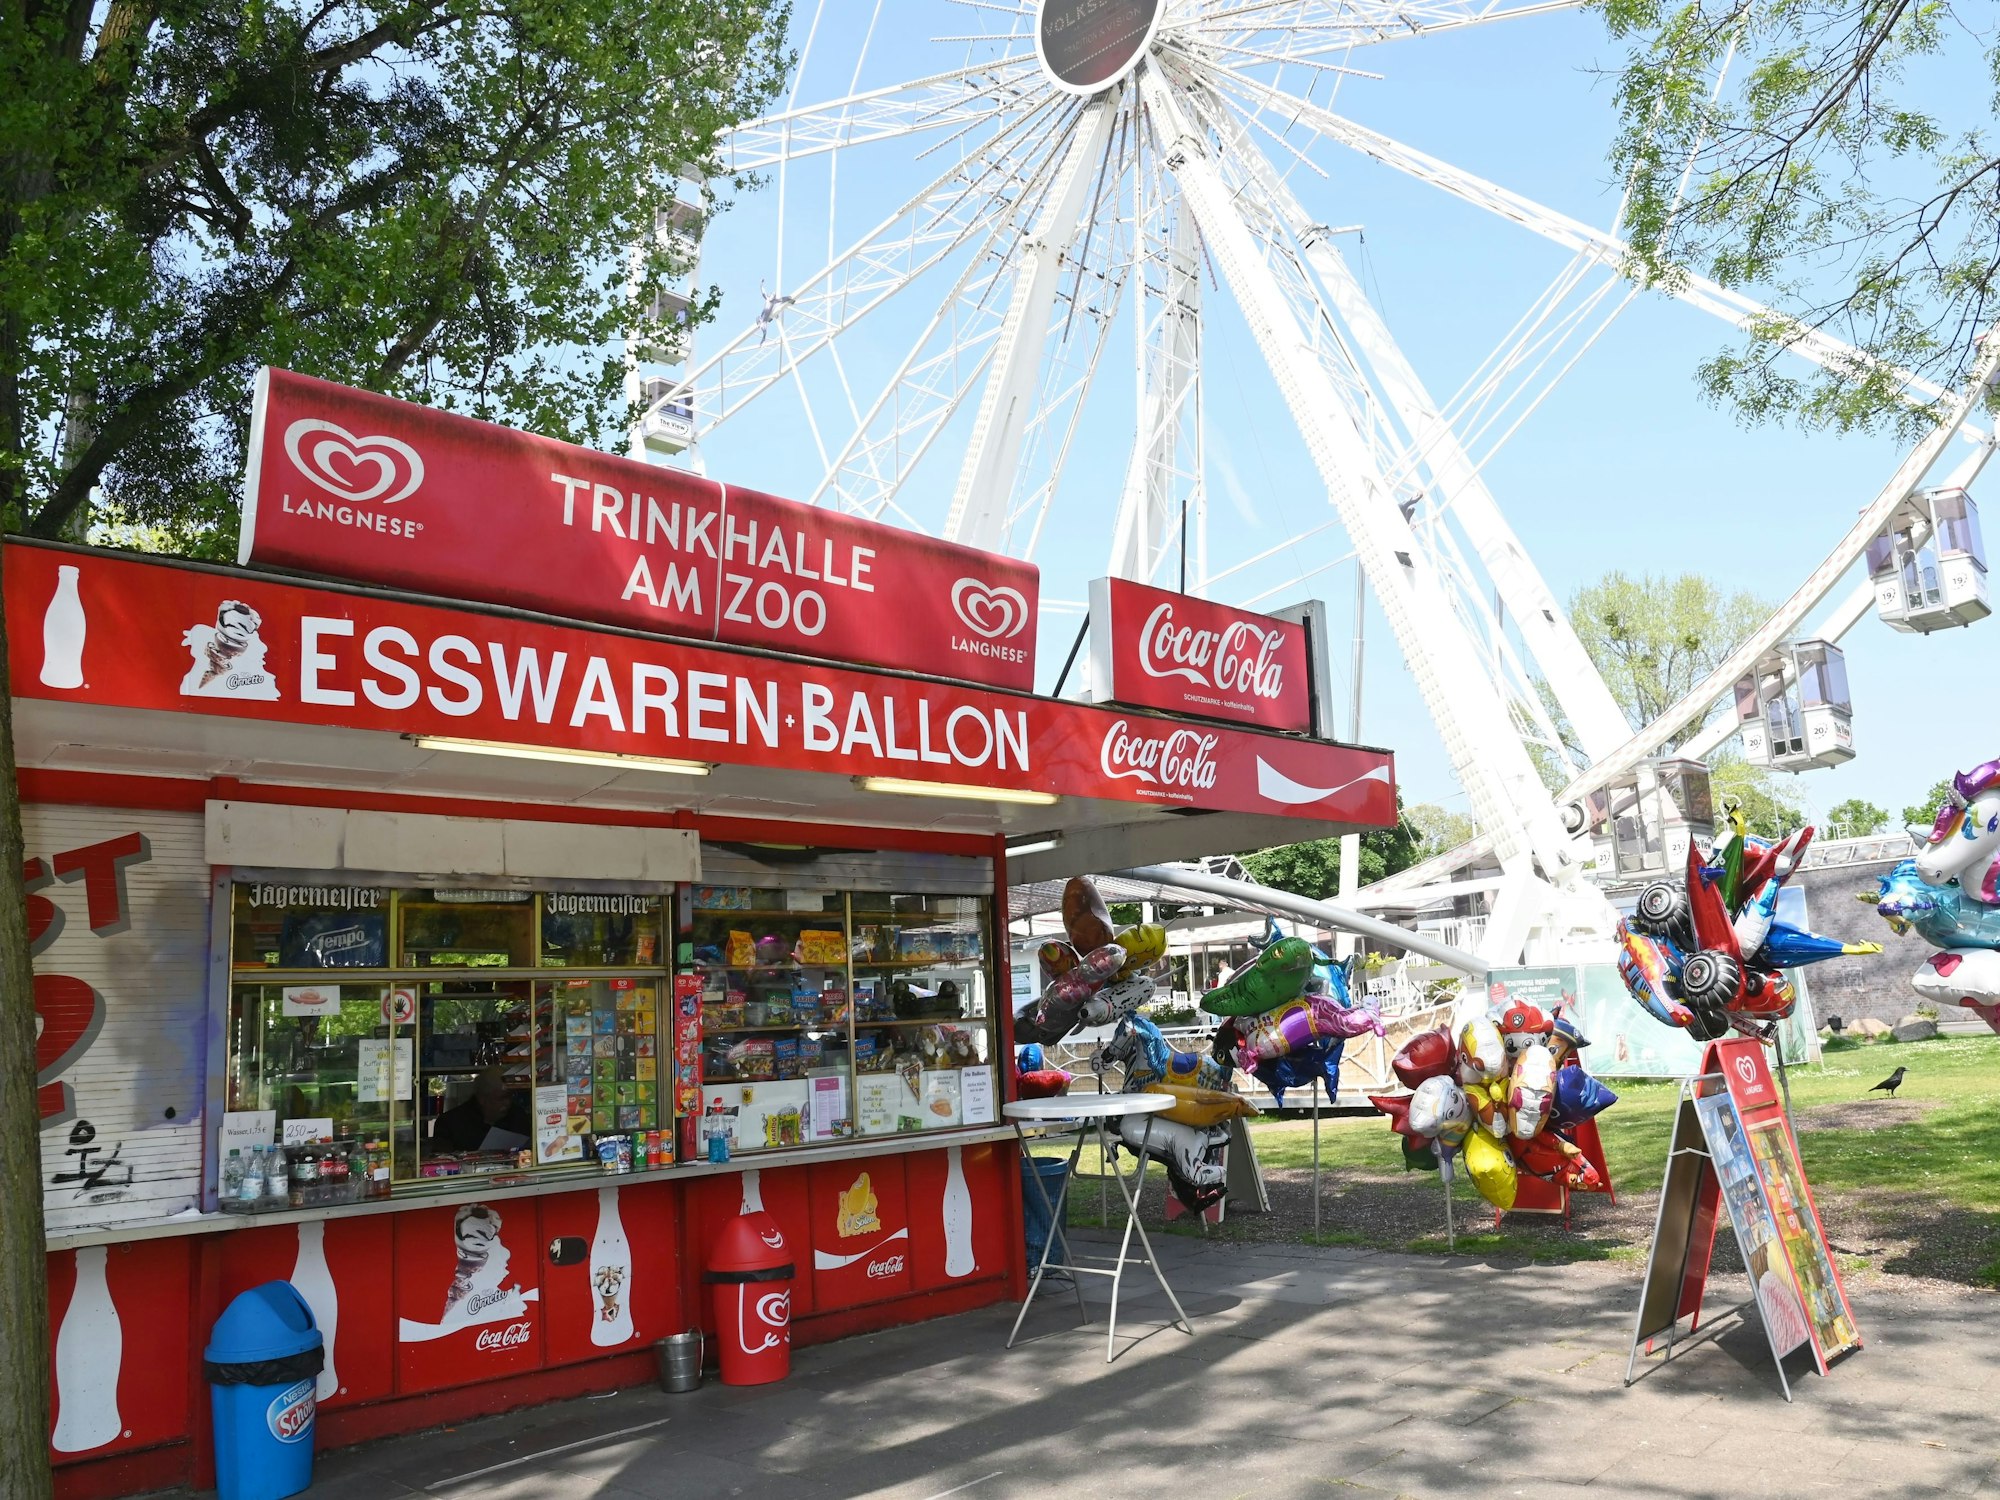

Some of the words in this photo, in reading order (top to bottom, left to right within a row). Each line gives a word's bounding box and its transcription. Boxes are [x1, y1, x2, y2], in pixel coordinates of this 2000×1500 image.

[660, 418, 670, 426] The
[671, 421, 685, 431] View
[551, 472, 876, 593] TRINKHALLE
[1952, 576, 1963, 585] 19
[621, 554, 703, 616] AM
[723, 573, 827, 637] ZOO
[1882, 591, 1892, 600] 19
[1139, 602, 1286, 699] Coca-Cola
[226, 673, 265, 691] Cornetto
[301, 616, 779, 749] ESSWAREN
[802, 681, 1030, 772] BALLON
[1183, 693, 1221, 707] SCHUTZMARKE
[1223, 701, 1256, 714] koffeinhaltig
[1749, 738, 1759, 747] 20
[1814, 727, 1825, 735] 20
[1100, 719, 1219, 789] Coca-Cola
[317, 929, 366, 951] Tempo
[867, 1254, 905, 1278] Coca-Cola
[467, 1287, 509, 1316] Cornetto
[475, 1321, 532, 1351] Coca-Cola
